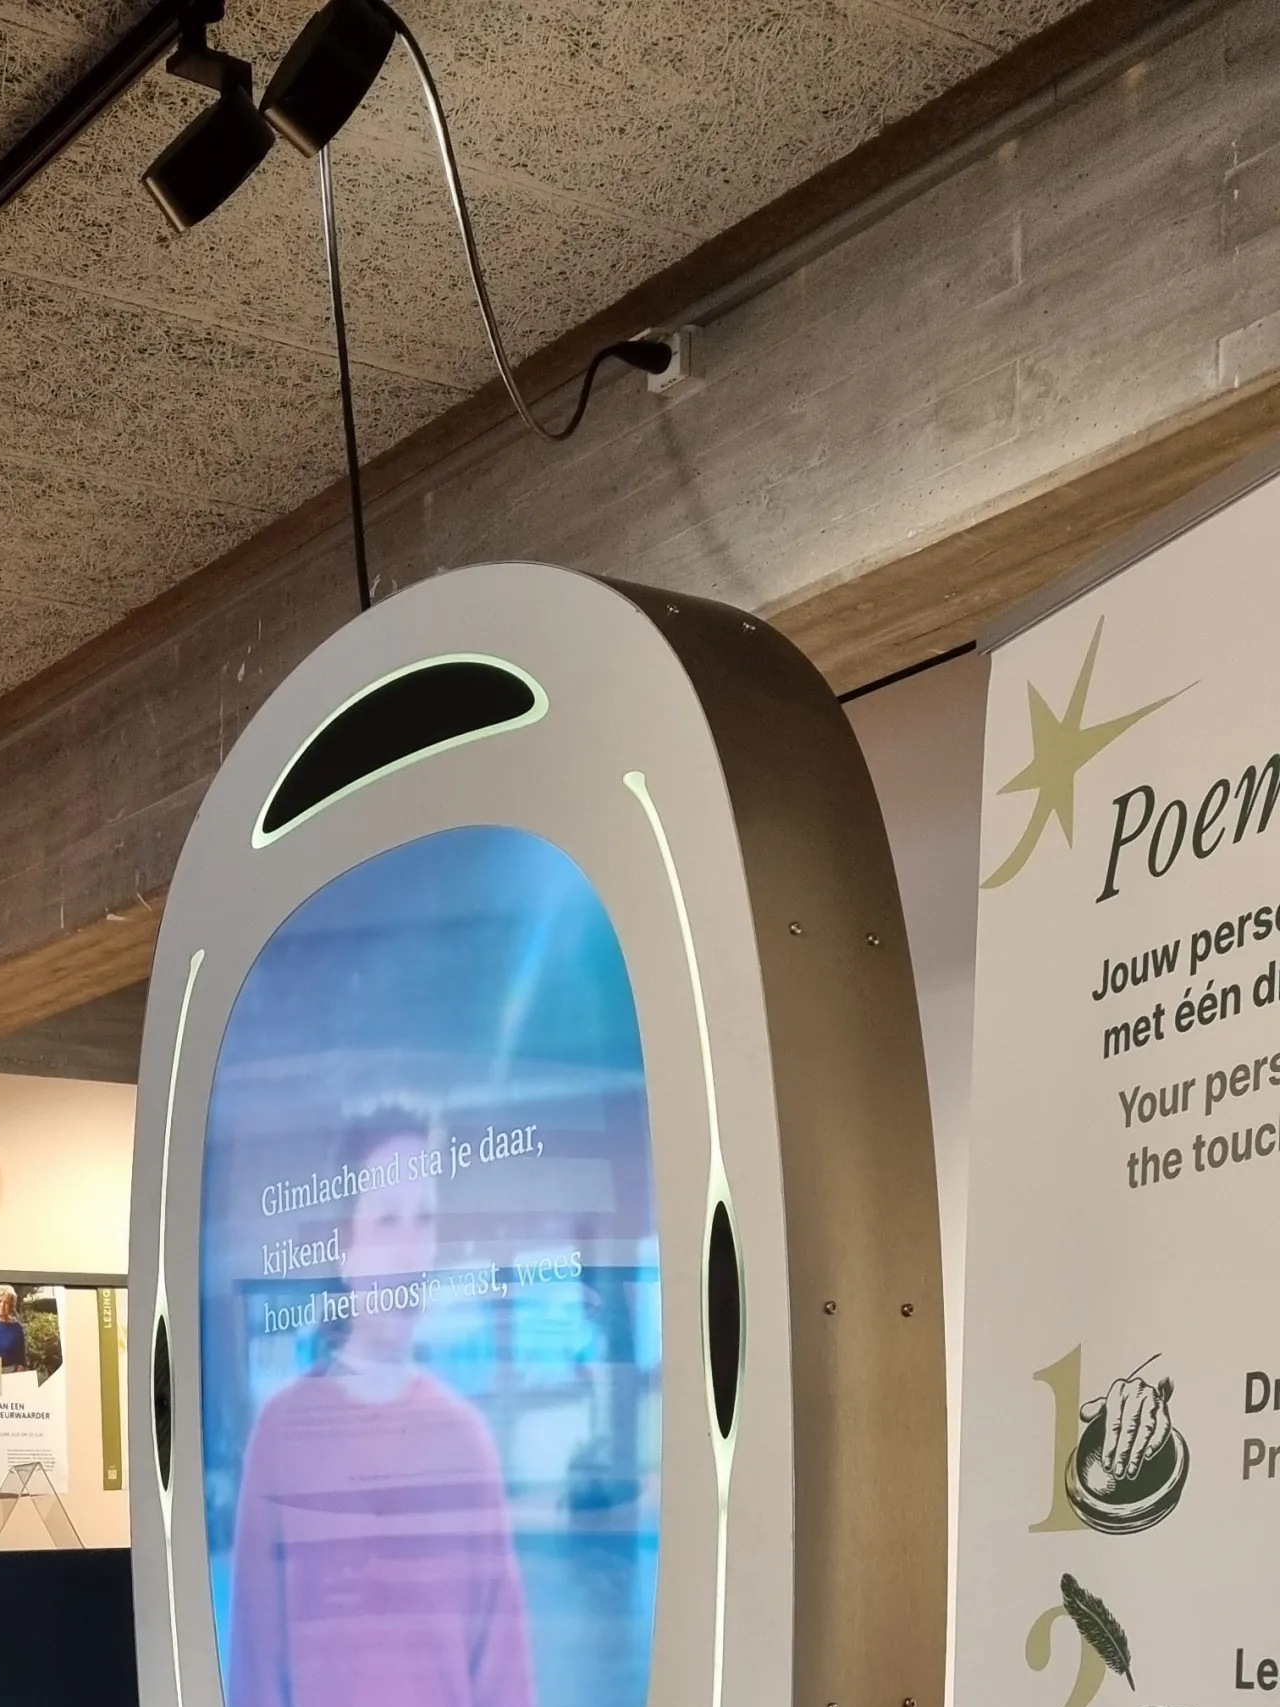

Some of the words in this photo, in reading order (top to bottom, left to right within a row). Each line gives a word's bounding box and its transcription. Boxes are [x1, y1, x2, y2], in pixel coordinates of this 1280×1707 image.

[1092, 939, 1181, 1001] Jouw
[1190, 903, 1280, 976] pers
[1103, 1003, 1165, 1059] met
[1175, 979, 1241, 1033] één
[1253, 960, 1280, 1007] d
[1118, 1078, 1196, 1128] Your
[261, 1152, 400, 1216] Glimlachend
[408, 1149, 442, 1180] sta
[450, 1136, 472, 1180] je
[479, 1125, 544, 1158] daar,
[1127, 1146, 1182, 1189] the
[1193, 1116, 1280, 1172] touc
[262, 1228, 346, 1279] kijkend,
[264, 1293, 317, 1333] houd
[323, 1289, 359, 1322] het
[366, 1272, 441, 1315] doosje
[448, 1262, 508, 1298] vast,
[516, 1251, 582, 1287] wees
[11, 1402, 24, 1410] EEN
